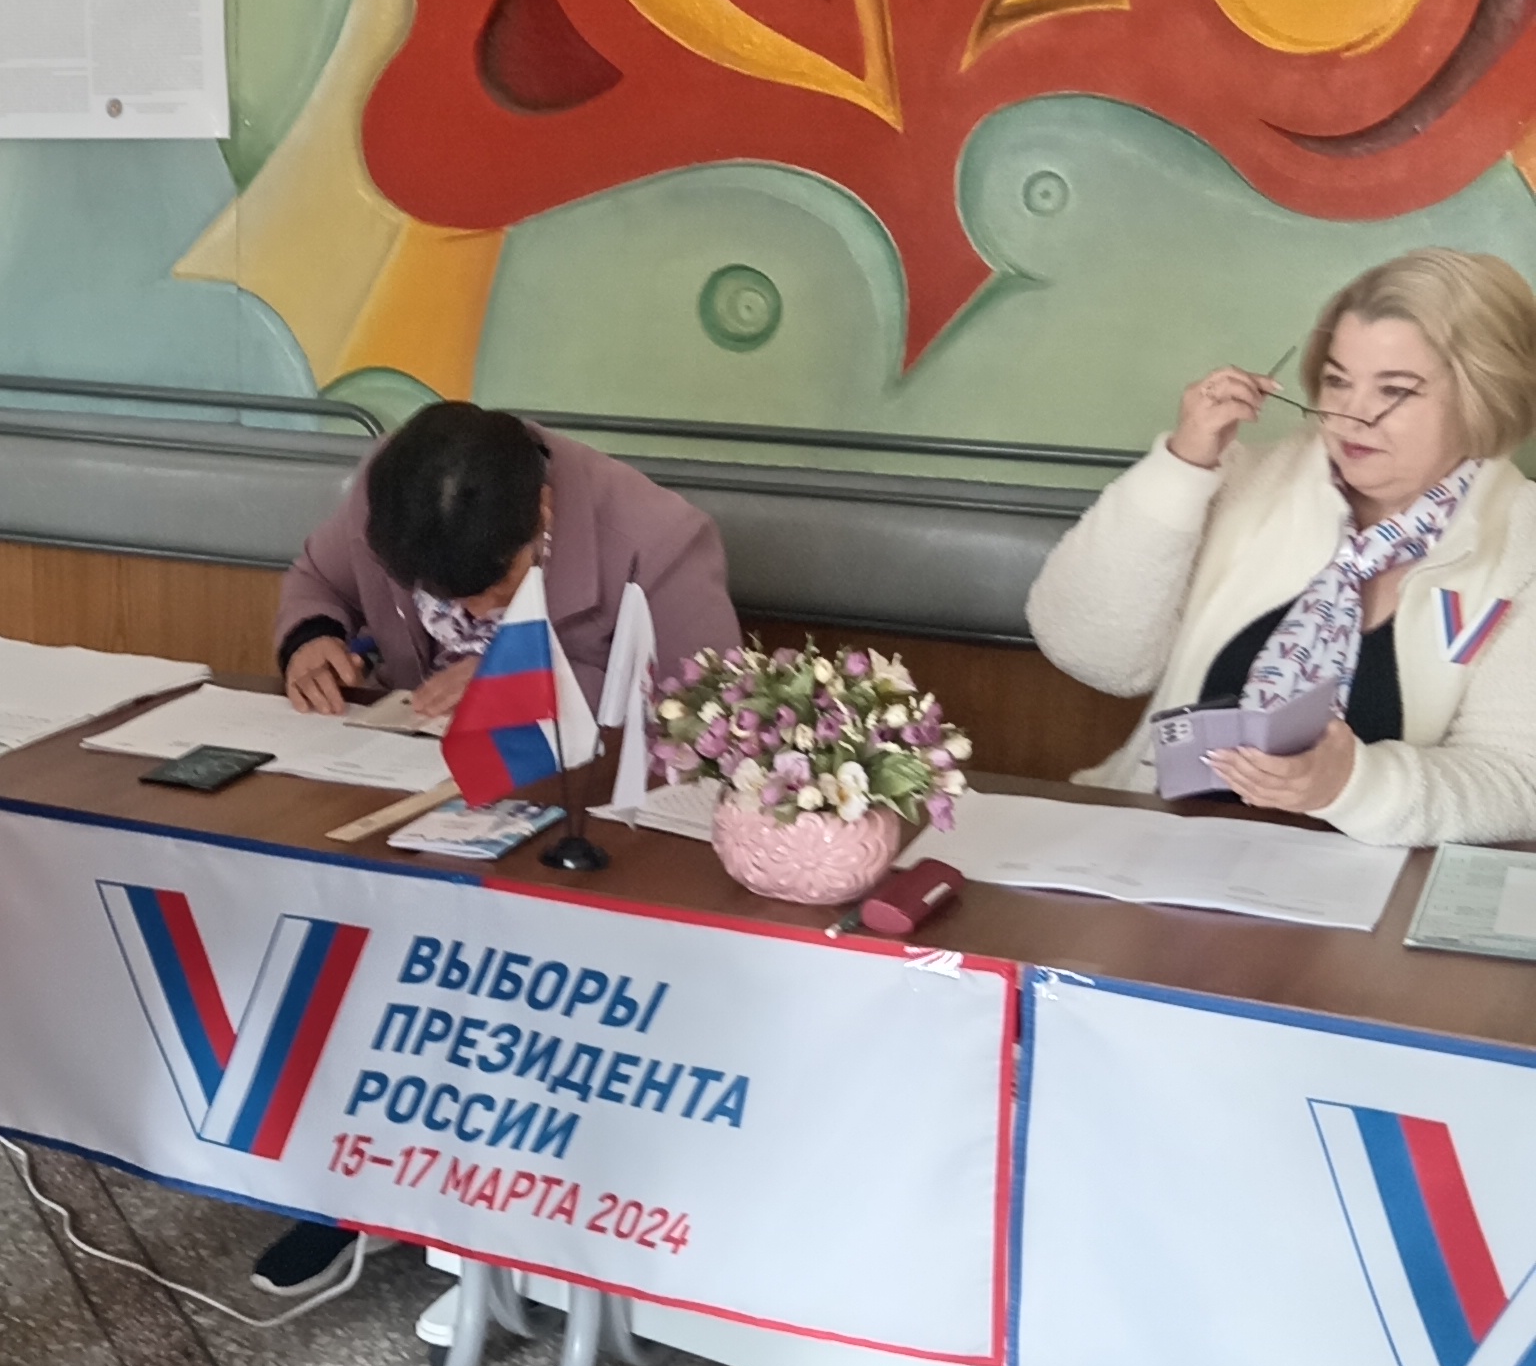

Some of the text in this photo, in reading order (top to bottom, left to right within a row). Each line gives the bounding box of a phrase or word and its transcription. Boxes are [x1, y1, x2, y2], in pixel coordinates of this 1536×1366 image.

[397, 934, 670, 1034] ВЫБОРЫ
[344, 1069, 582, 1160] РОССИИ
[371, 1002, 751, 1128] ПРЕЗИДЕНТА
[440, 1156, 581, 1225] МАРТА
[585, 1191, 692, 1255] 2024
